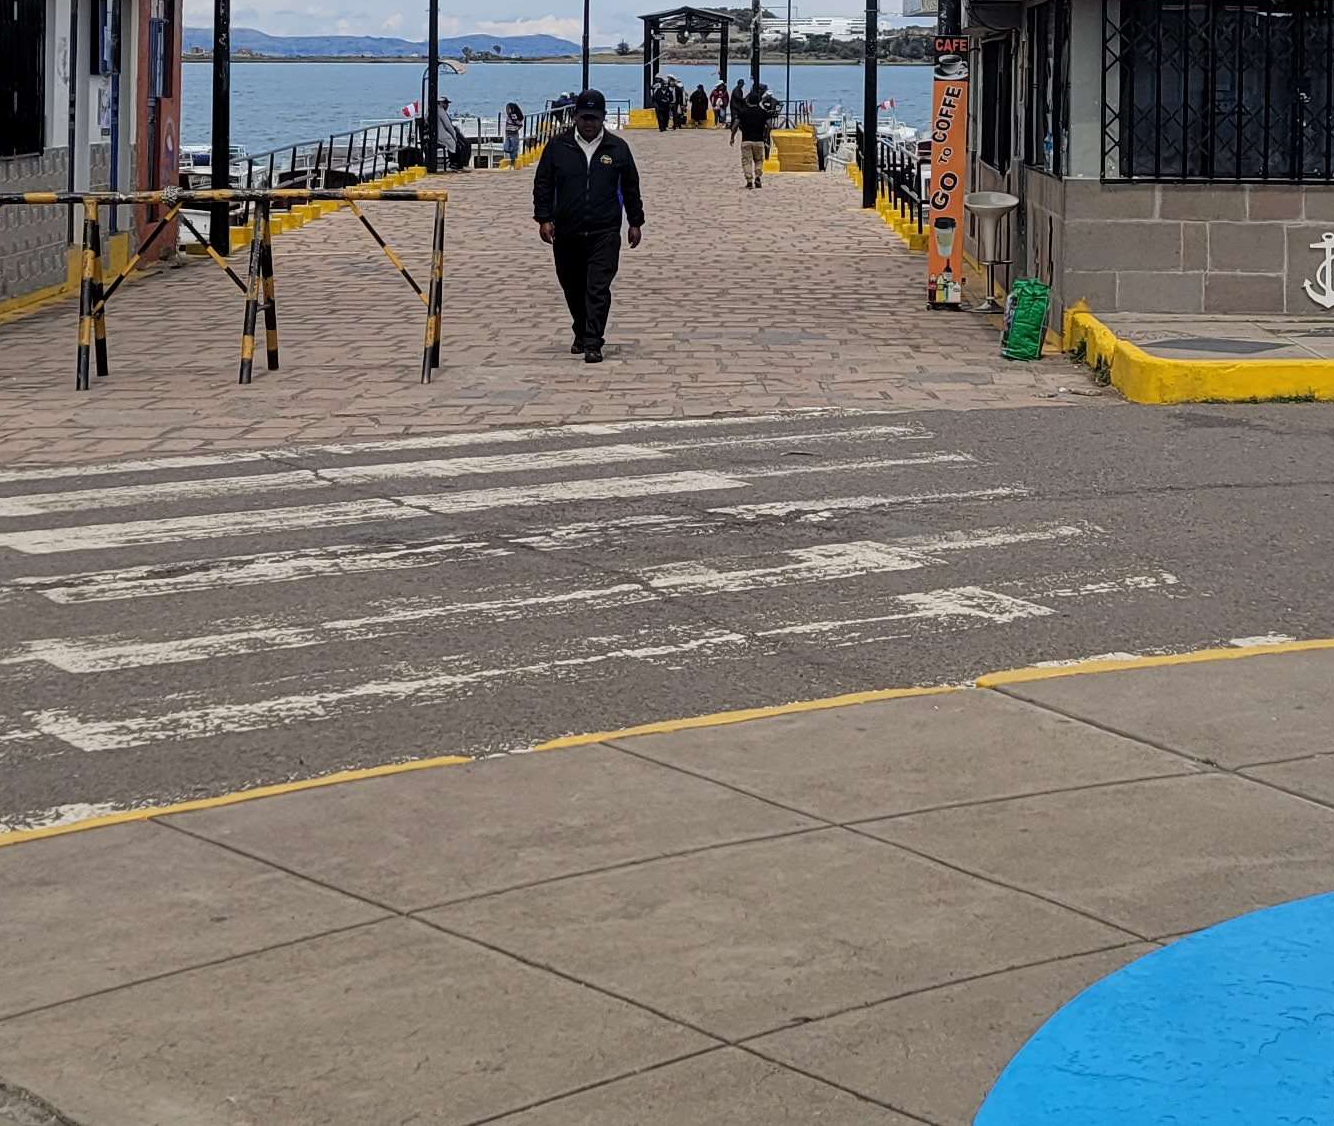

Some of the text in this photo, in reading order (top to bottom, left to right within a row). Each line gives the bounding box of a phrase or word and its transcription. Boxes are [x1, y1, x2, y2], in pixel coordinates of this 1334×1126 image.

[935, 38, 967, 52] CAFE
[931, 86, 962, 212] GO TO COFFE
